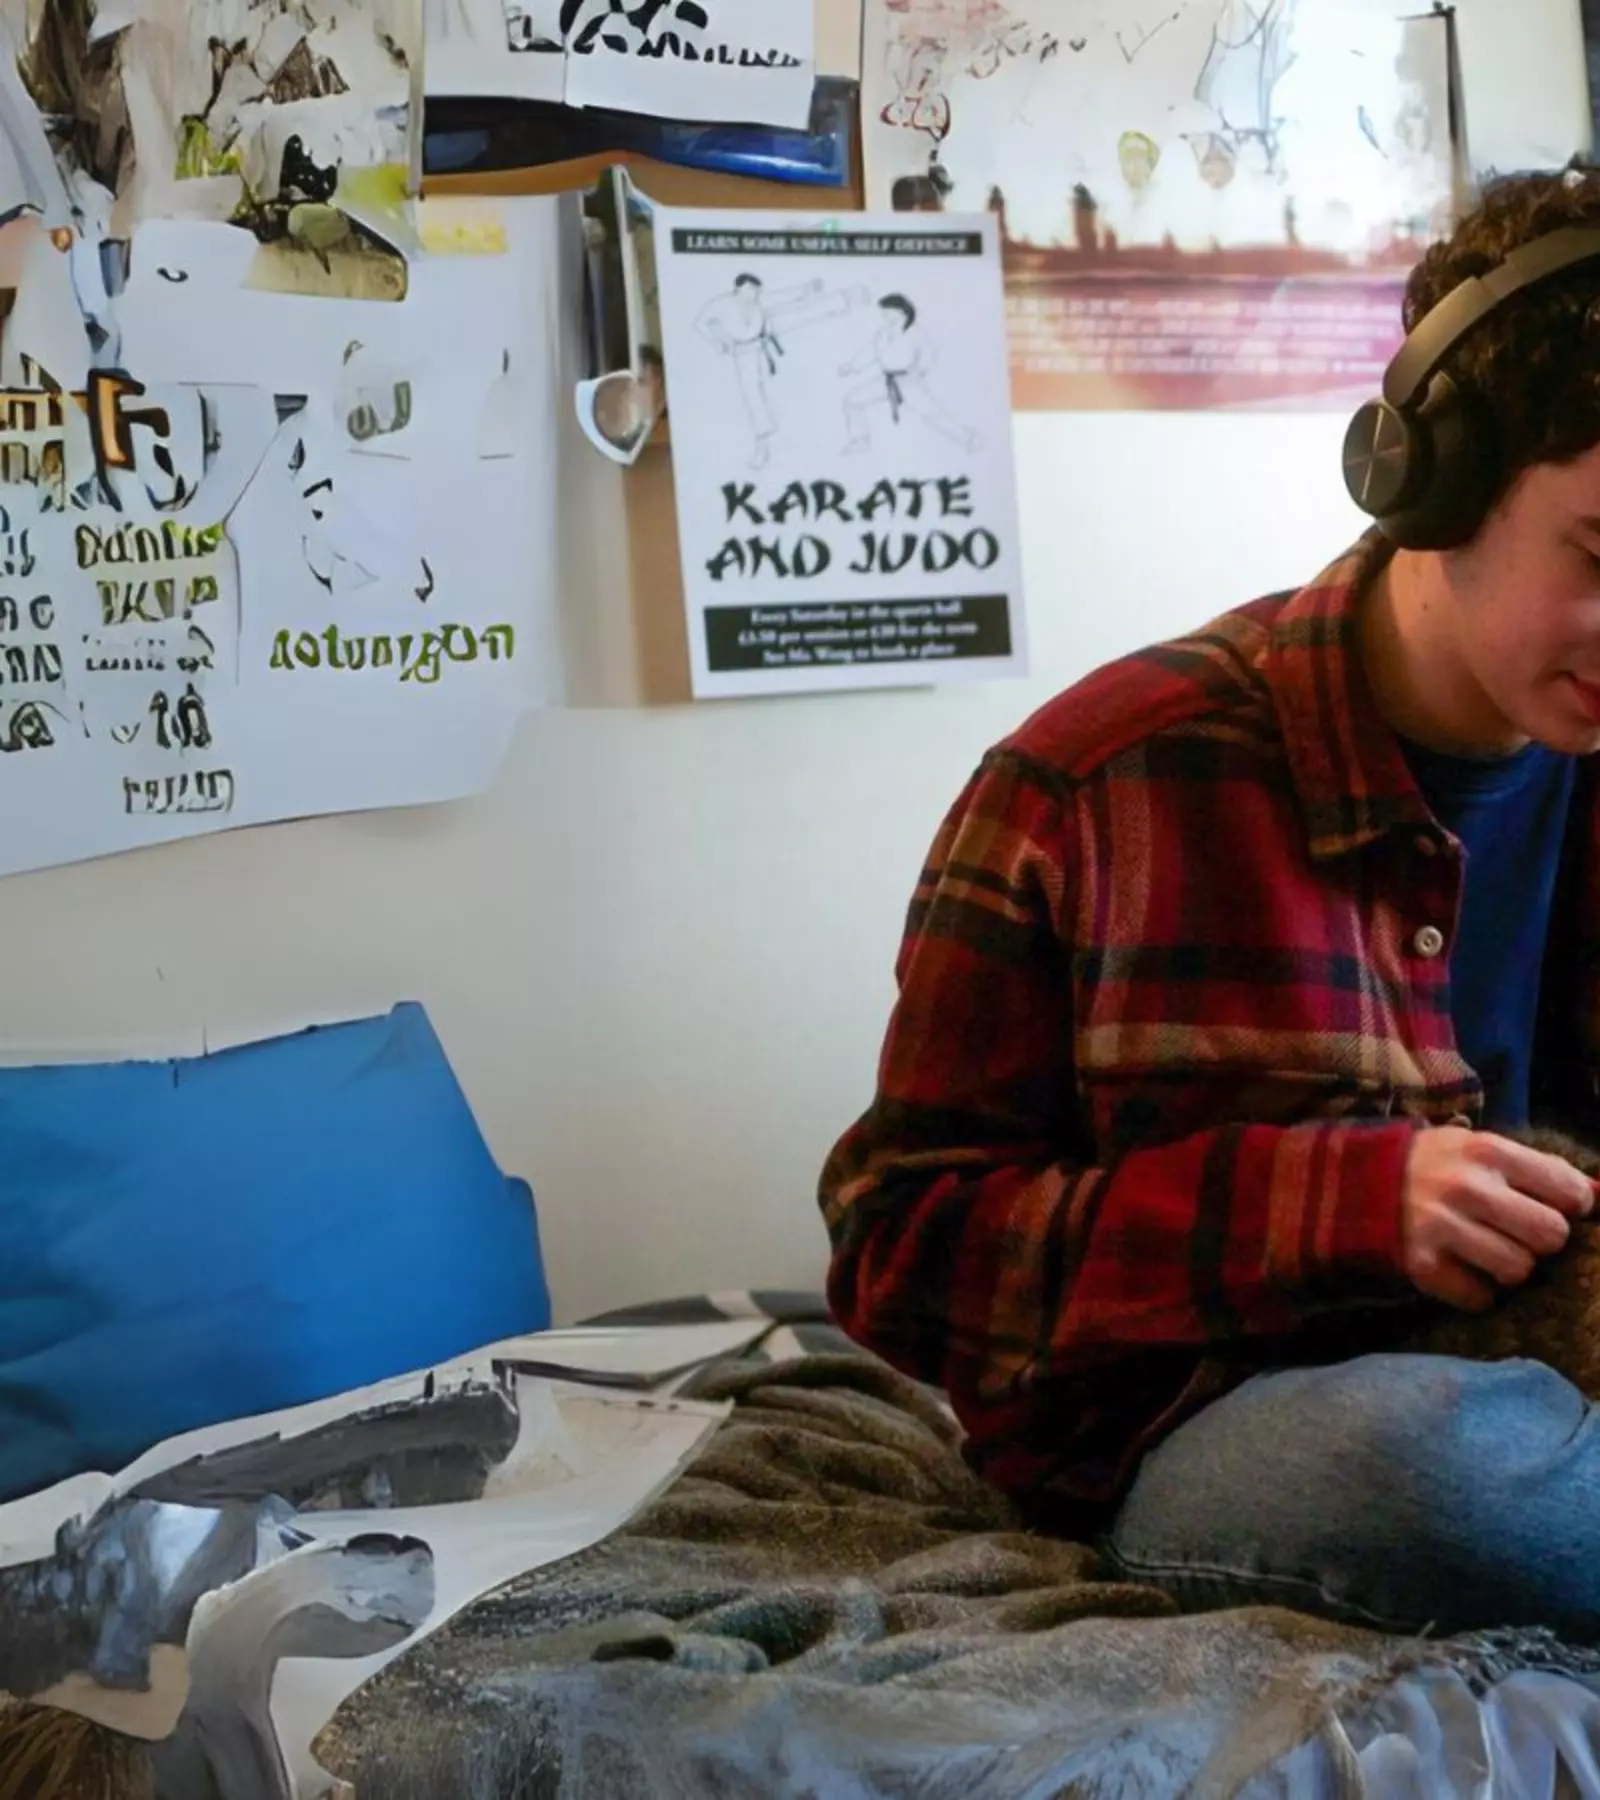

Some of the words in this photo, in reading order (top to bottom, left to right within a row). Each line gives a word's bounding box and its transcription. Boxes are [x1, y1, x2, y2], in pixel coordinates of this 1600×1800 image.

[686, 234, 739, 250] LEARN
[742, 235, 786, 251] SOME
[790, 236, 848, 251] USEFUL
[853, 237, 891, 252] SELF
[894, 237, 968, 252] DEFENCE
[721, 474, 973, 525] KARATE
[704, 534, 832, 581] AND
[848, 527, 999, 574] JUDO
